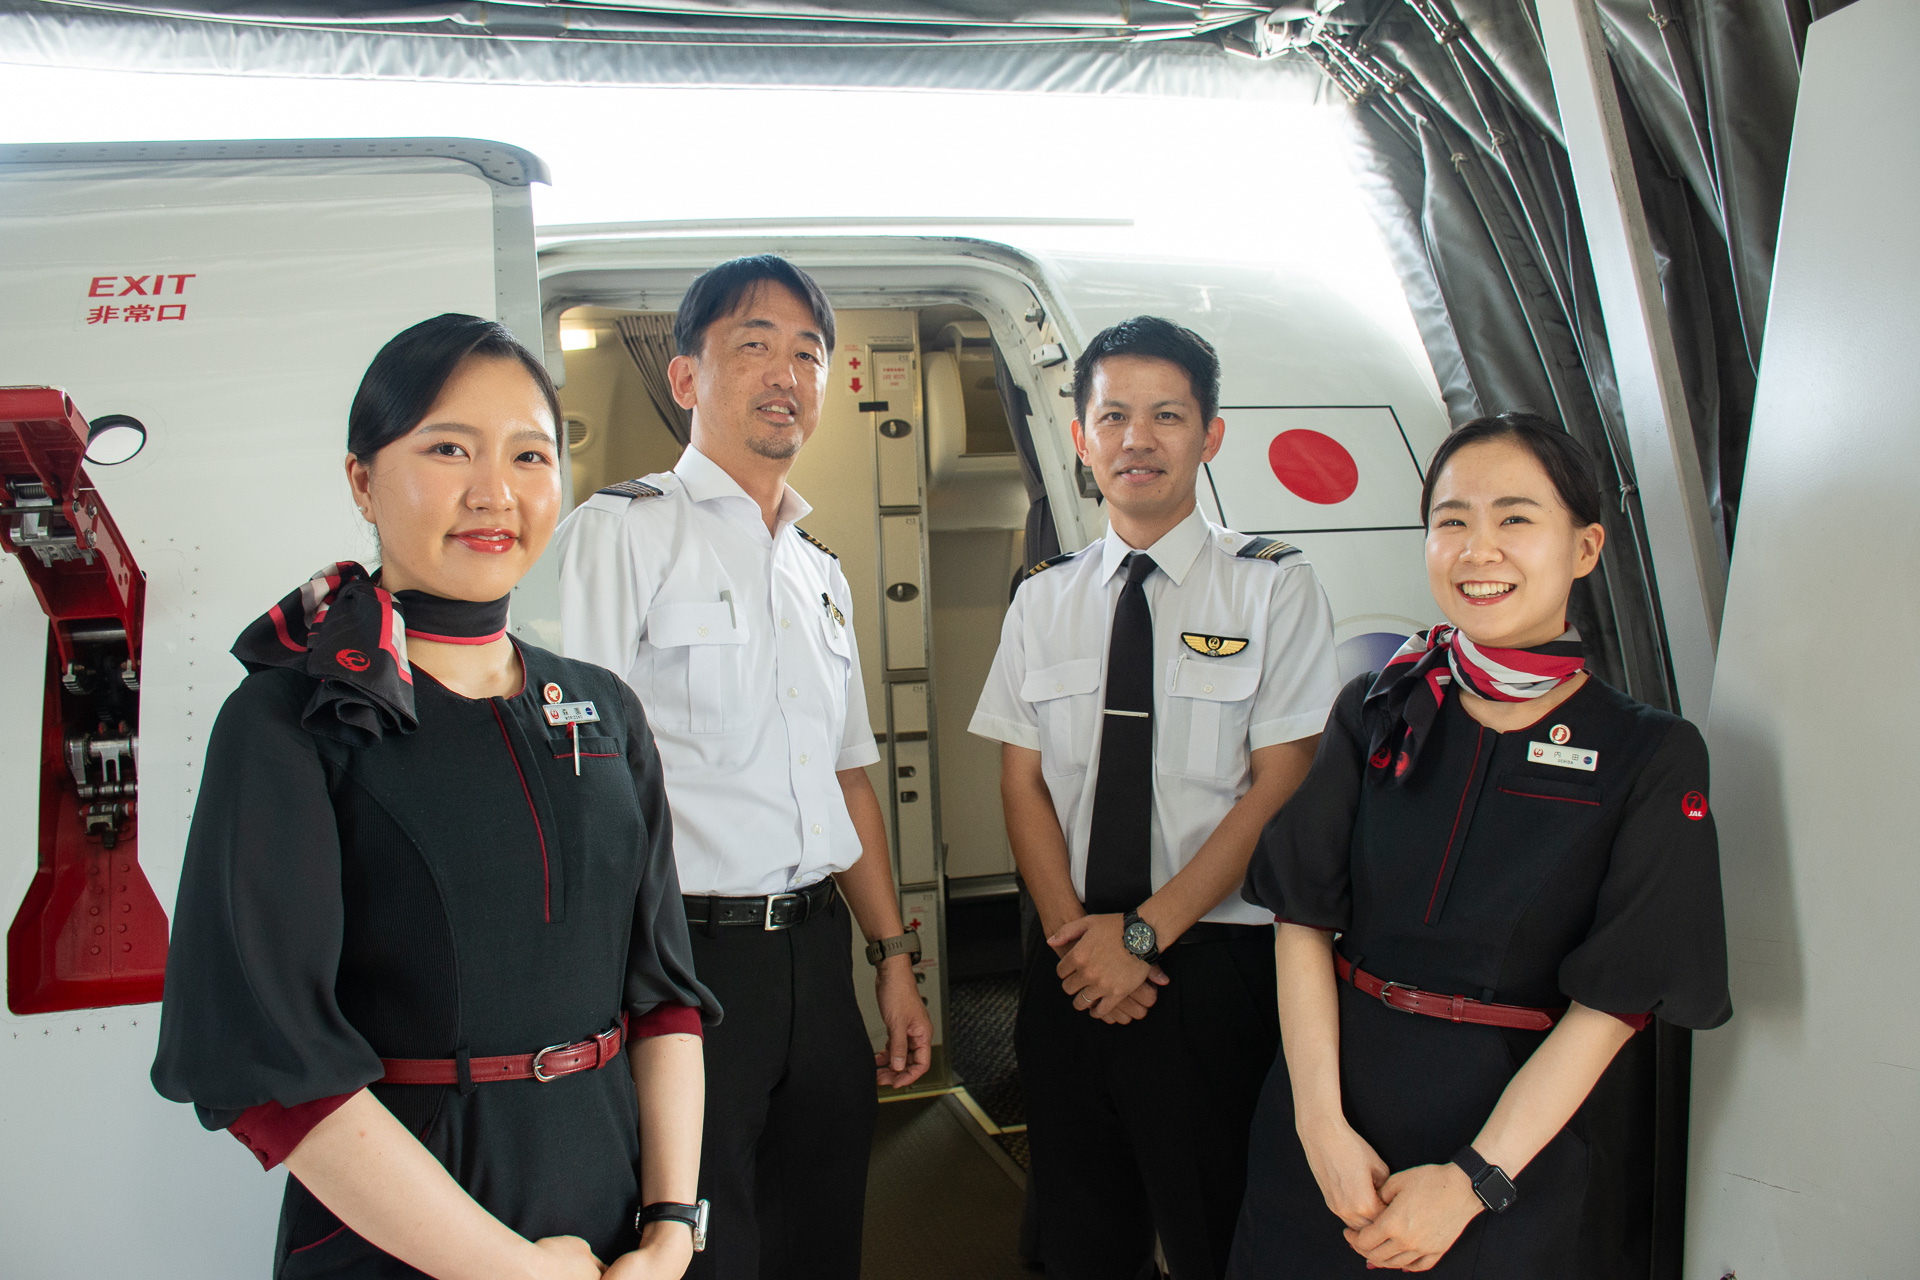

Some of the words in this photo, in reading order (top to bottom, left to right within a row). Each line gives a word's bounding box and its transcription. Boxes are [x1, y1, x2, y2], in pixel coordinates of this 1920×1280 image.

[88, 274, 196, 297] EXIT
[86, 304, 187, 325] 非常口
